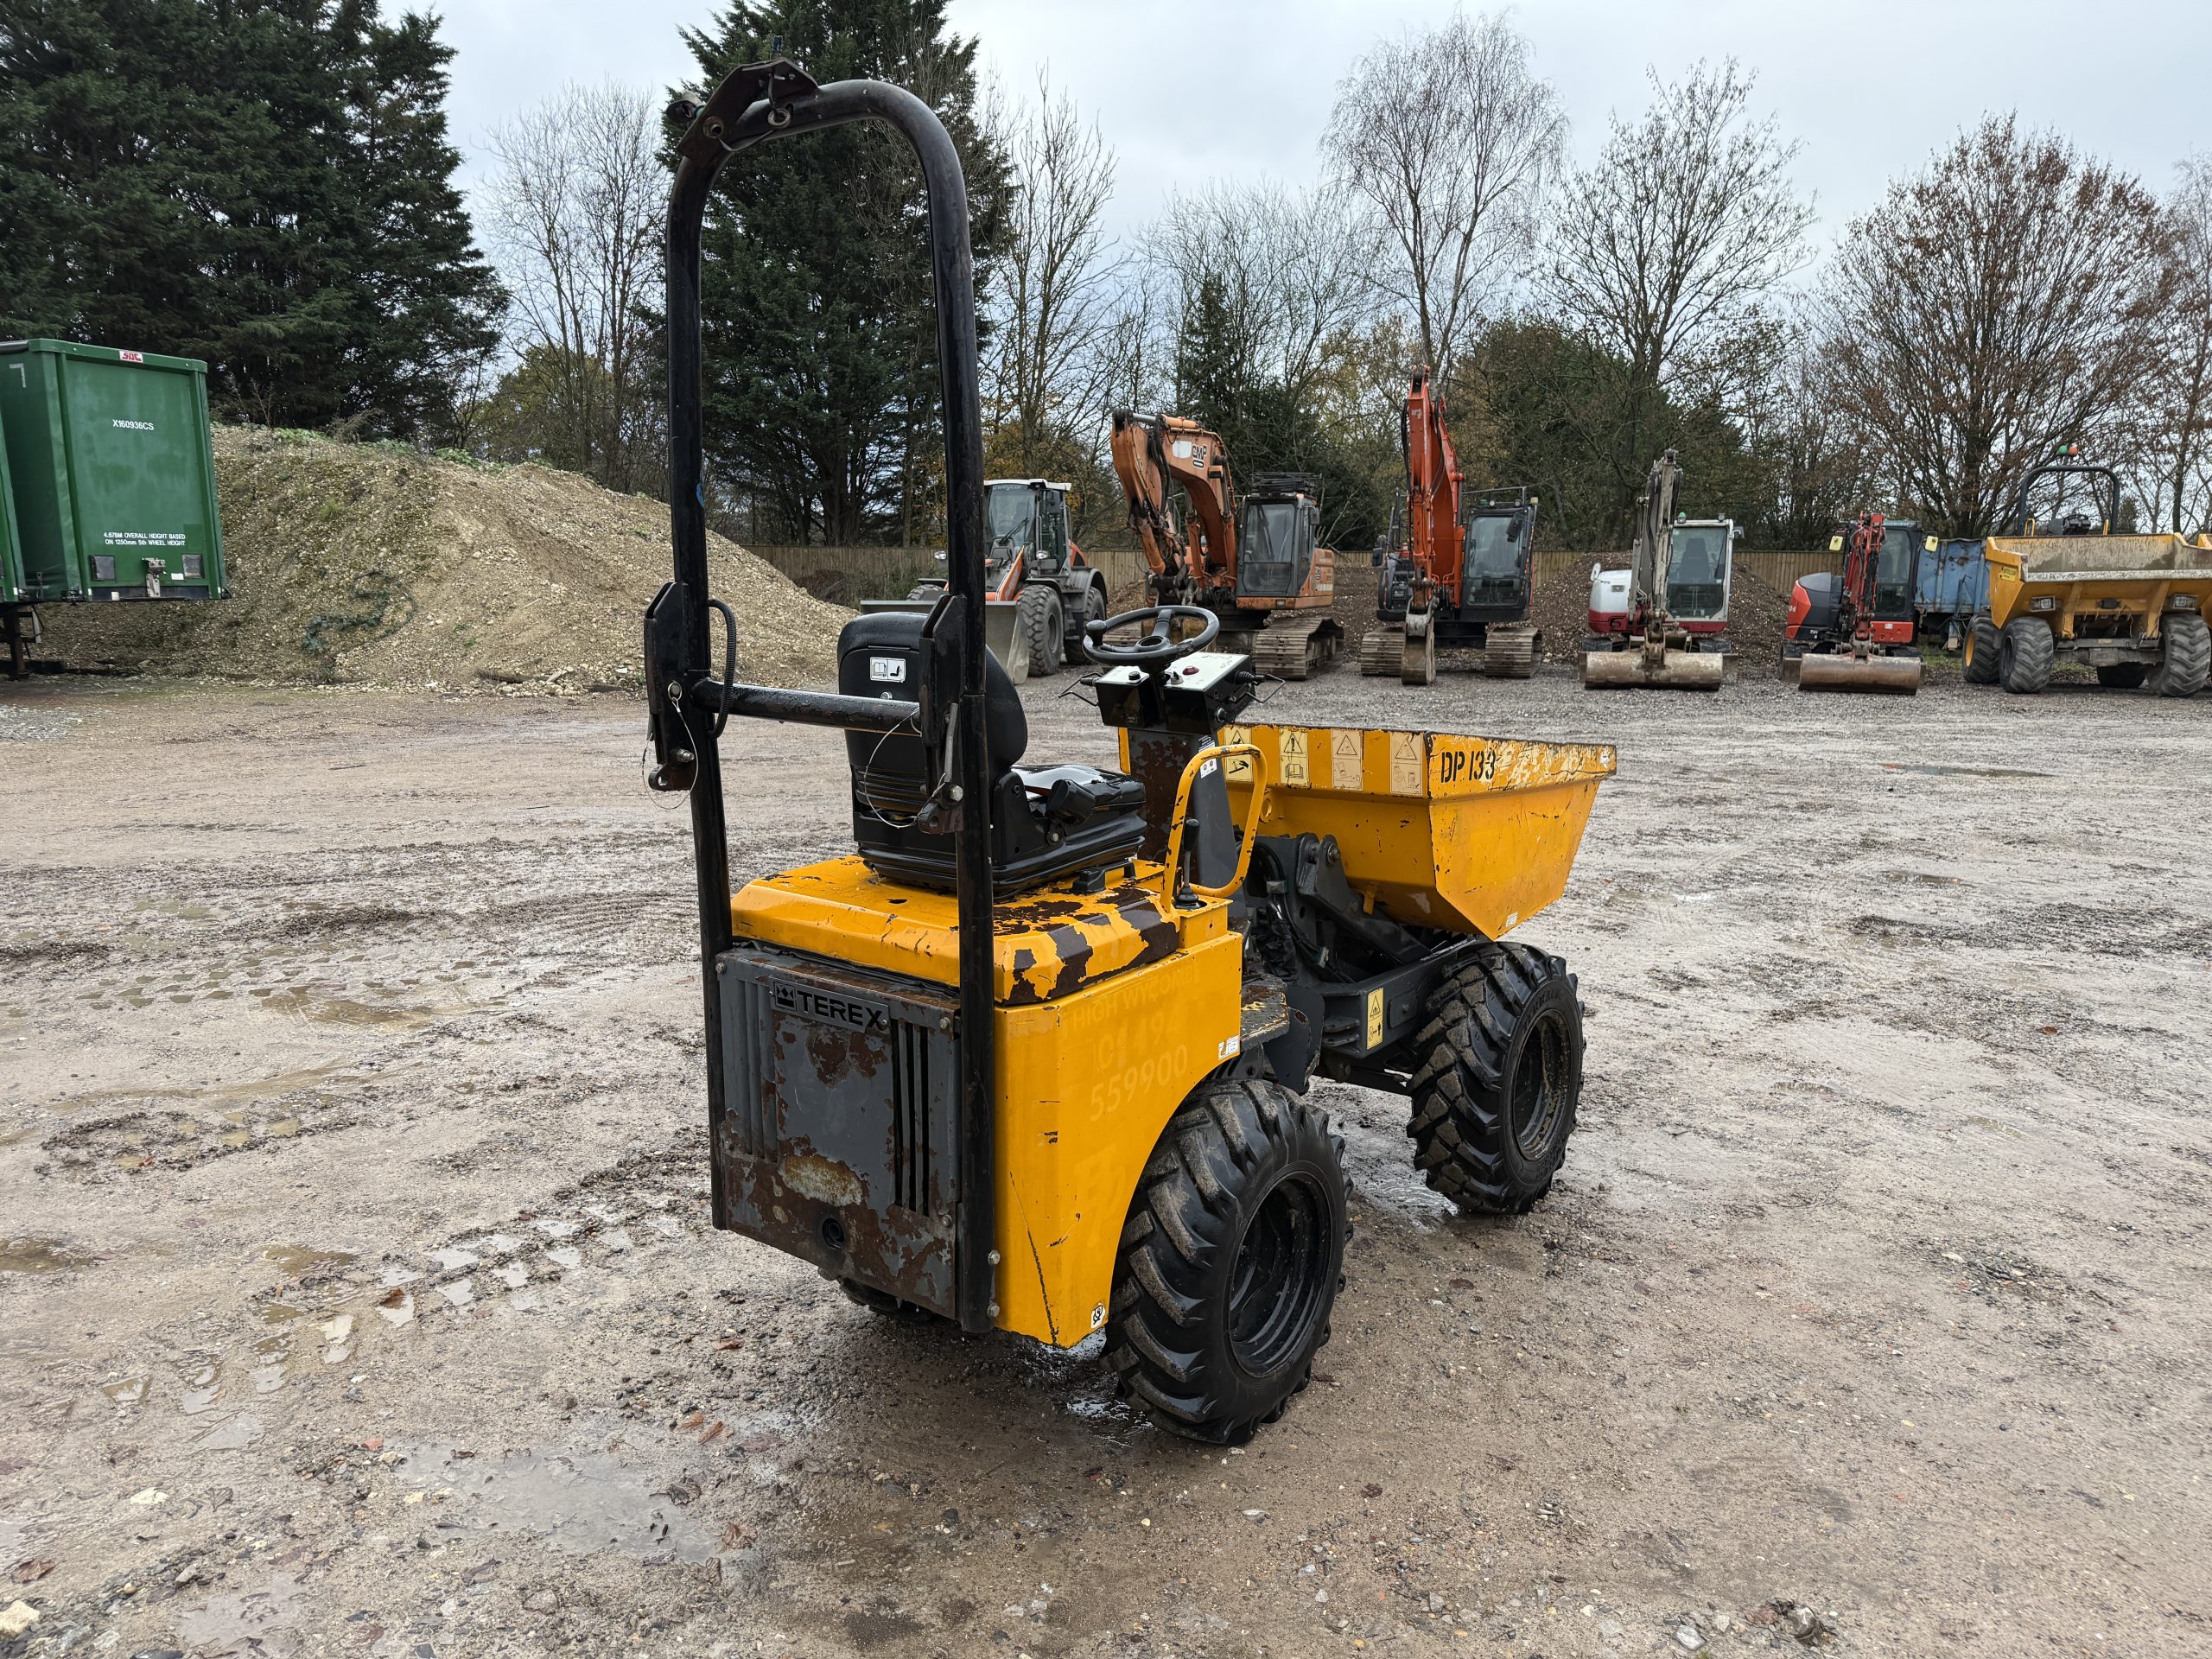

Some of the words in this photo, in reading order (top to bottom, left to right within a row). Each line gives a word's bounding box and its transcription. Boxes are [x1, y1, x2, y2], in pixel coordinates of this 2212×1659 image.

[122, 352, 143, 362] SDC
[112, 419, 155, 430] X160936CS
[1441, 751, 1465, 783] DP
[1468, 749, 1497, 781] 133
[797, 990, 884, 1032] TEREX
[1072, 995, 1118, 1032] HIGH
[1090, 1044, 1188, 1122] 559900
